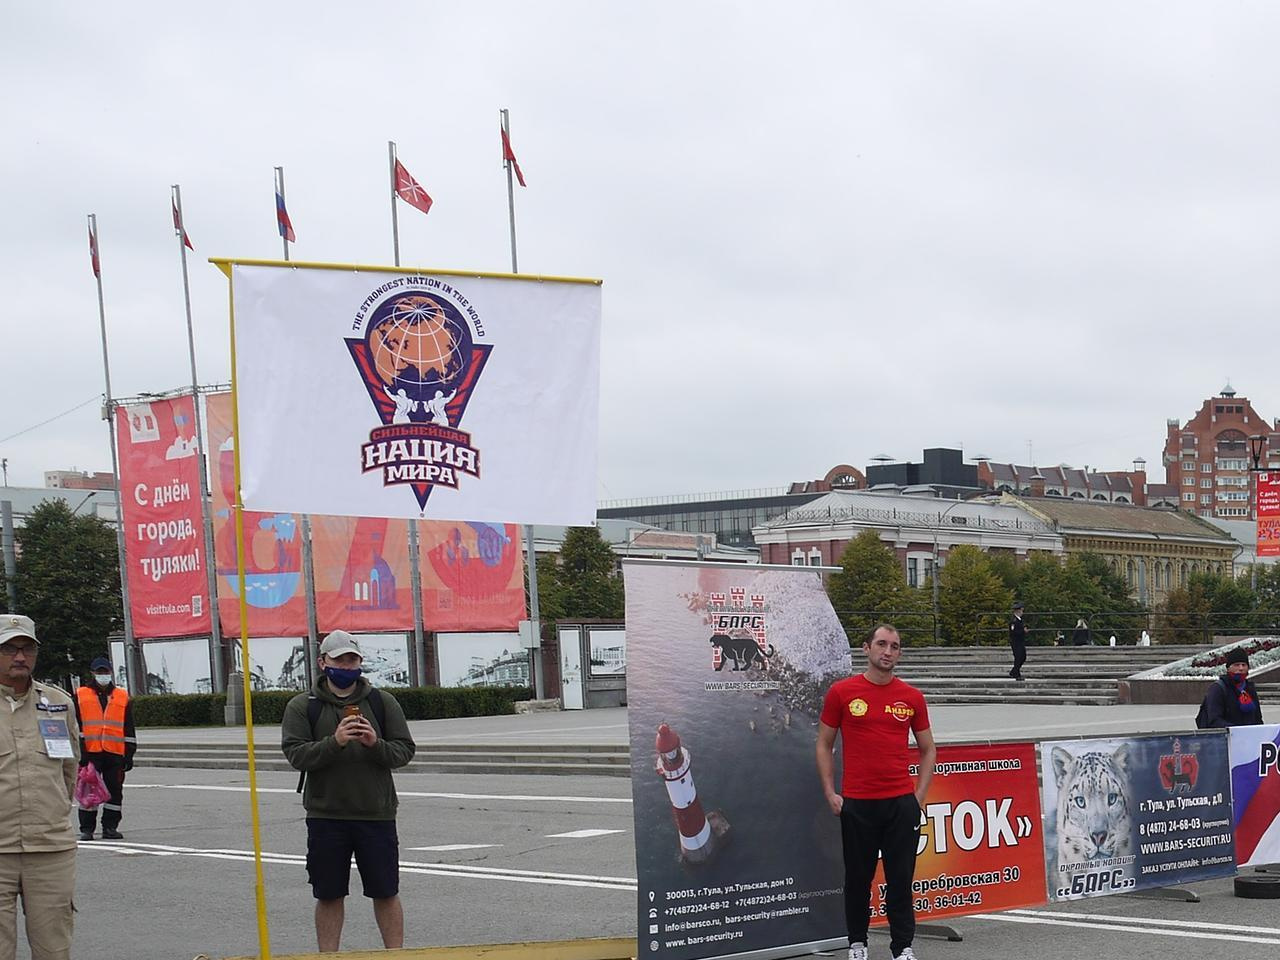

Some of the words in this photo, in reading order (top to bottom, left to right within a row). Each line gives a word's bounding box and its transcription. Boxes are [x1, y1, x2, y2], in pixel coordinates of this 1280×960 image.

[352, 312, 365, 331] THE
[362, 278, 405, 313] STRONGEST
[406, 276, 441, 289] NATION
[442, 283, 452, 294] IN
[452, 289, 469, 307] THE
[466, 305, 486, 337] WORLD
[363, 439, 478, 473] НАЦИЯ
[386, 464, 456, 485] МИРА
[134, 483, 148, 505] С
[153, 479, 191, 507] днём
[136, 517, 197, 545] города,
[140, 548, 201, 582] туляки!
[145, 599, 191, 616] visittula.com
[933, 760, 986, 776] ортивная
[988, 758, 1021, 771] школа
[1140, 802, 1147, 812] г.
[1147, 799, 1165, 813] Тула,
[1166, 800, 1177, 812] ул.
[1176, 796, 1211, 810] Тульская,
[1139, 823, 1146, 835] 8
[1146, 821, 1167, 837] (4872)
[1168, 817, 1201, 832] 24-68-03
[1140, 833, 1232, 855] WWW.BARS-SECURITY.RU
[911, 870, 1001, 894] еребровская
[1003, 866, 1020, 882] 30
[1141, 865, 1159, 874] ЗАКАЗ
[665, 889, 697, 900] 300013,
[697, 887, 724, 897] г.Тула,
[724, 880, 770, 895] ул.Тульская,
[770, 879, 785, 889] дом
[785, 877, 794, 885] 10
[664, 900, 730, 916] +7(4872)24-68-12
[735, 891, 798, 907] +7(4872)24-68-03
[934, 891, 982, 909] 36-01-42
[664, 918, 722, 933] info@barsco.ru,
[724, 906, 810, 924] bars-security@rambler.ru
[665, 939, 686, 949] www.
[687, 930, 744, 945] bars-security.ru
